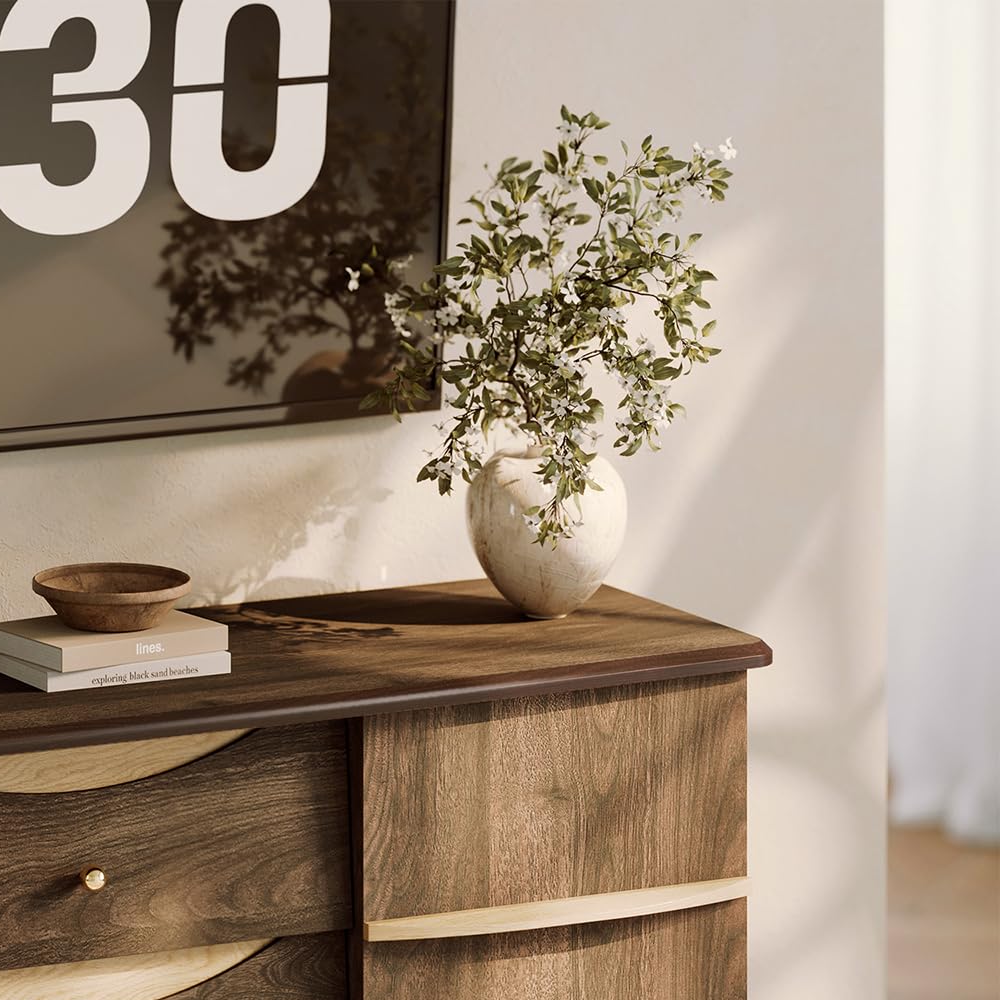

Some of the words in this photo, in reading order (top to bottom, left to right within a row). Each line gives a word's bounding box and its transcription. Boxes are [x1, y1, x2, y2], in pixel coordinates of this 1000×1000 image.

[135, 642, 165, 656] lines.
[91, 673, 128, 687] exploring
[129, 671, 150, 681] black
[150, 667, 168, 678] sand
[169, 665, 199, 677] beaches
